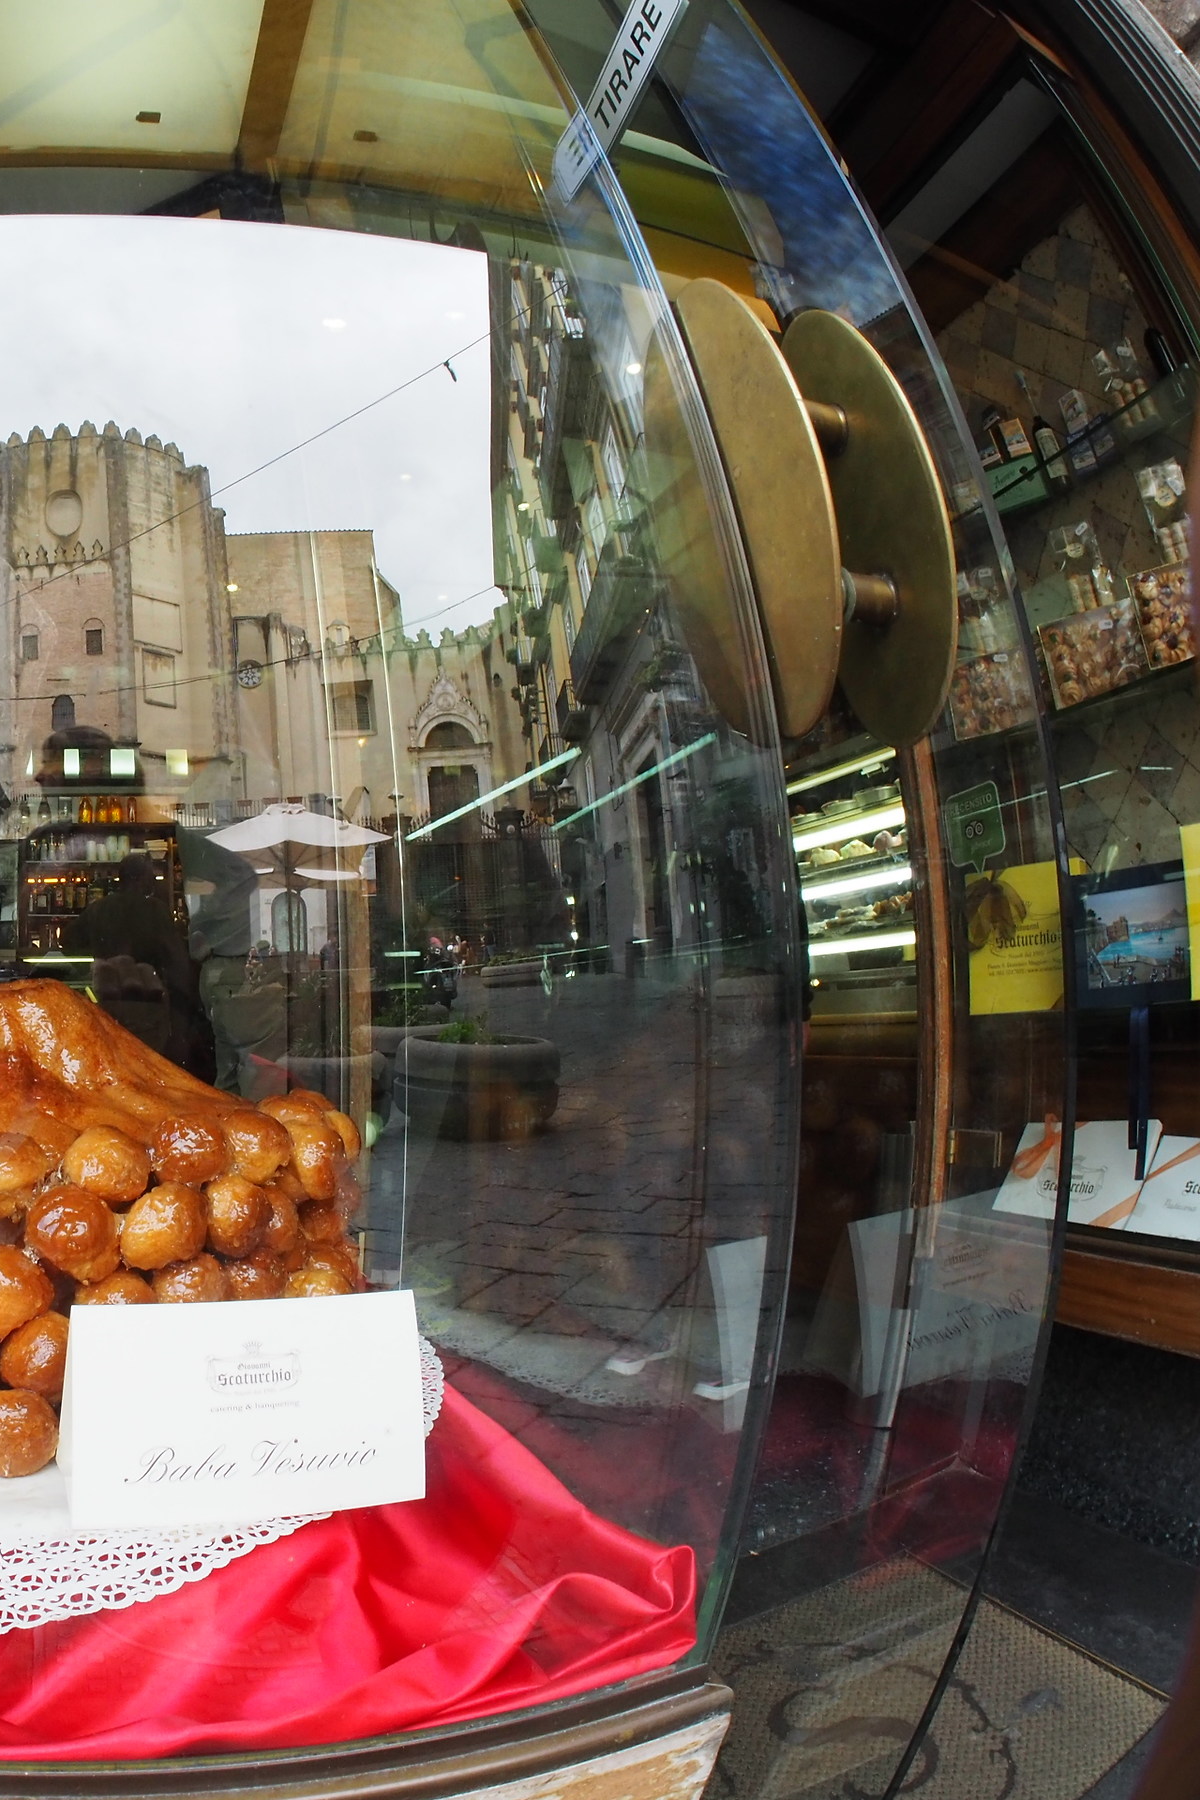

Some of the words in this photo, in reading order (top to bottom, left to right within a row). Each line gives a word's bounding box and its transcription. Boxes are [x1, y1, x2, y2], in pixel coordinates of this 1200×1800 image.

[594, 0, 663, 130] TIRARE
[217, 1368, 292, 1387] Scaturchio
[210, 1403, 243, 1413] catering
[123, 1443, 239, 1484] Baba
[250, 1437, 378, 1477] Vesuvio
